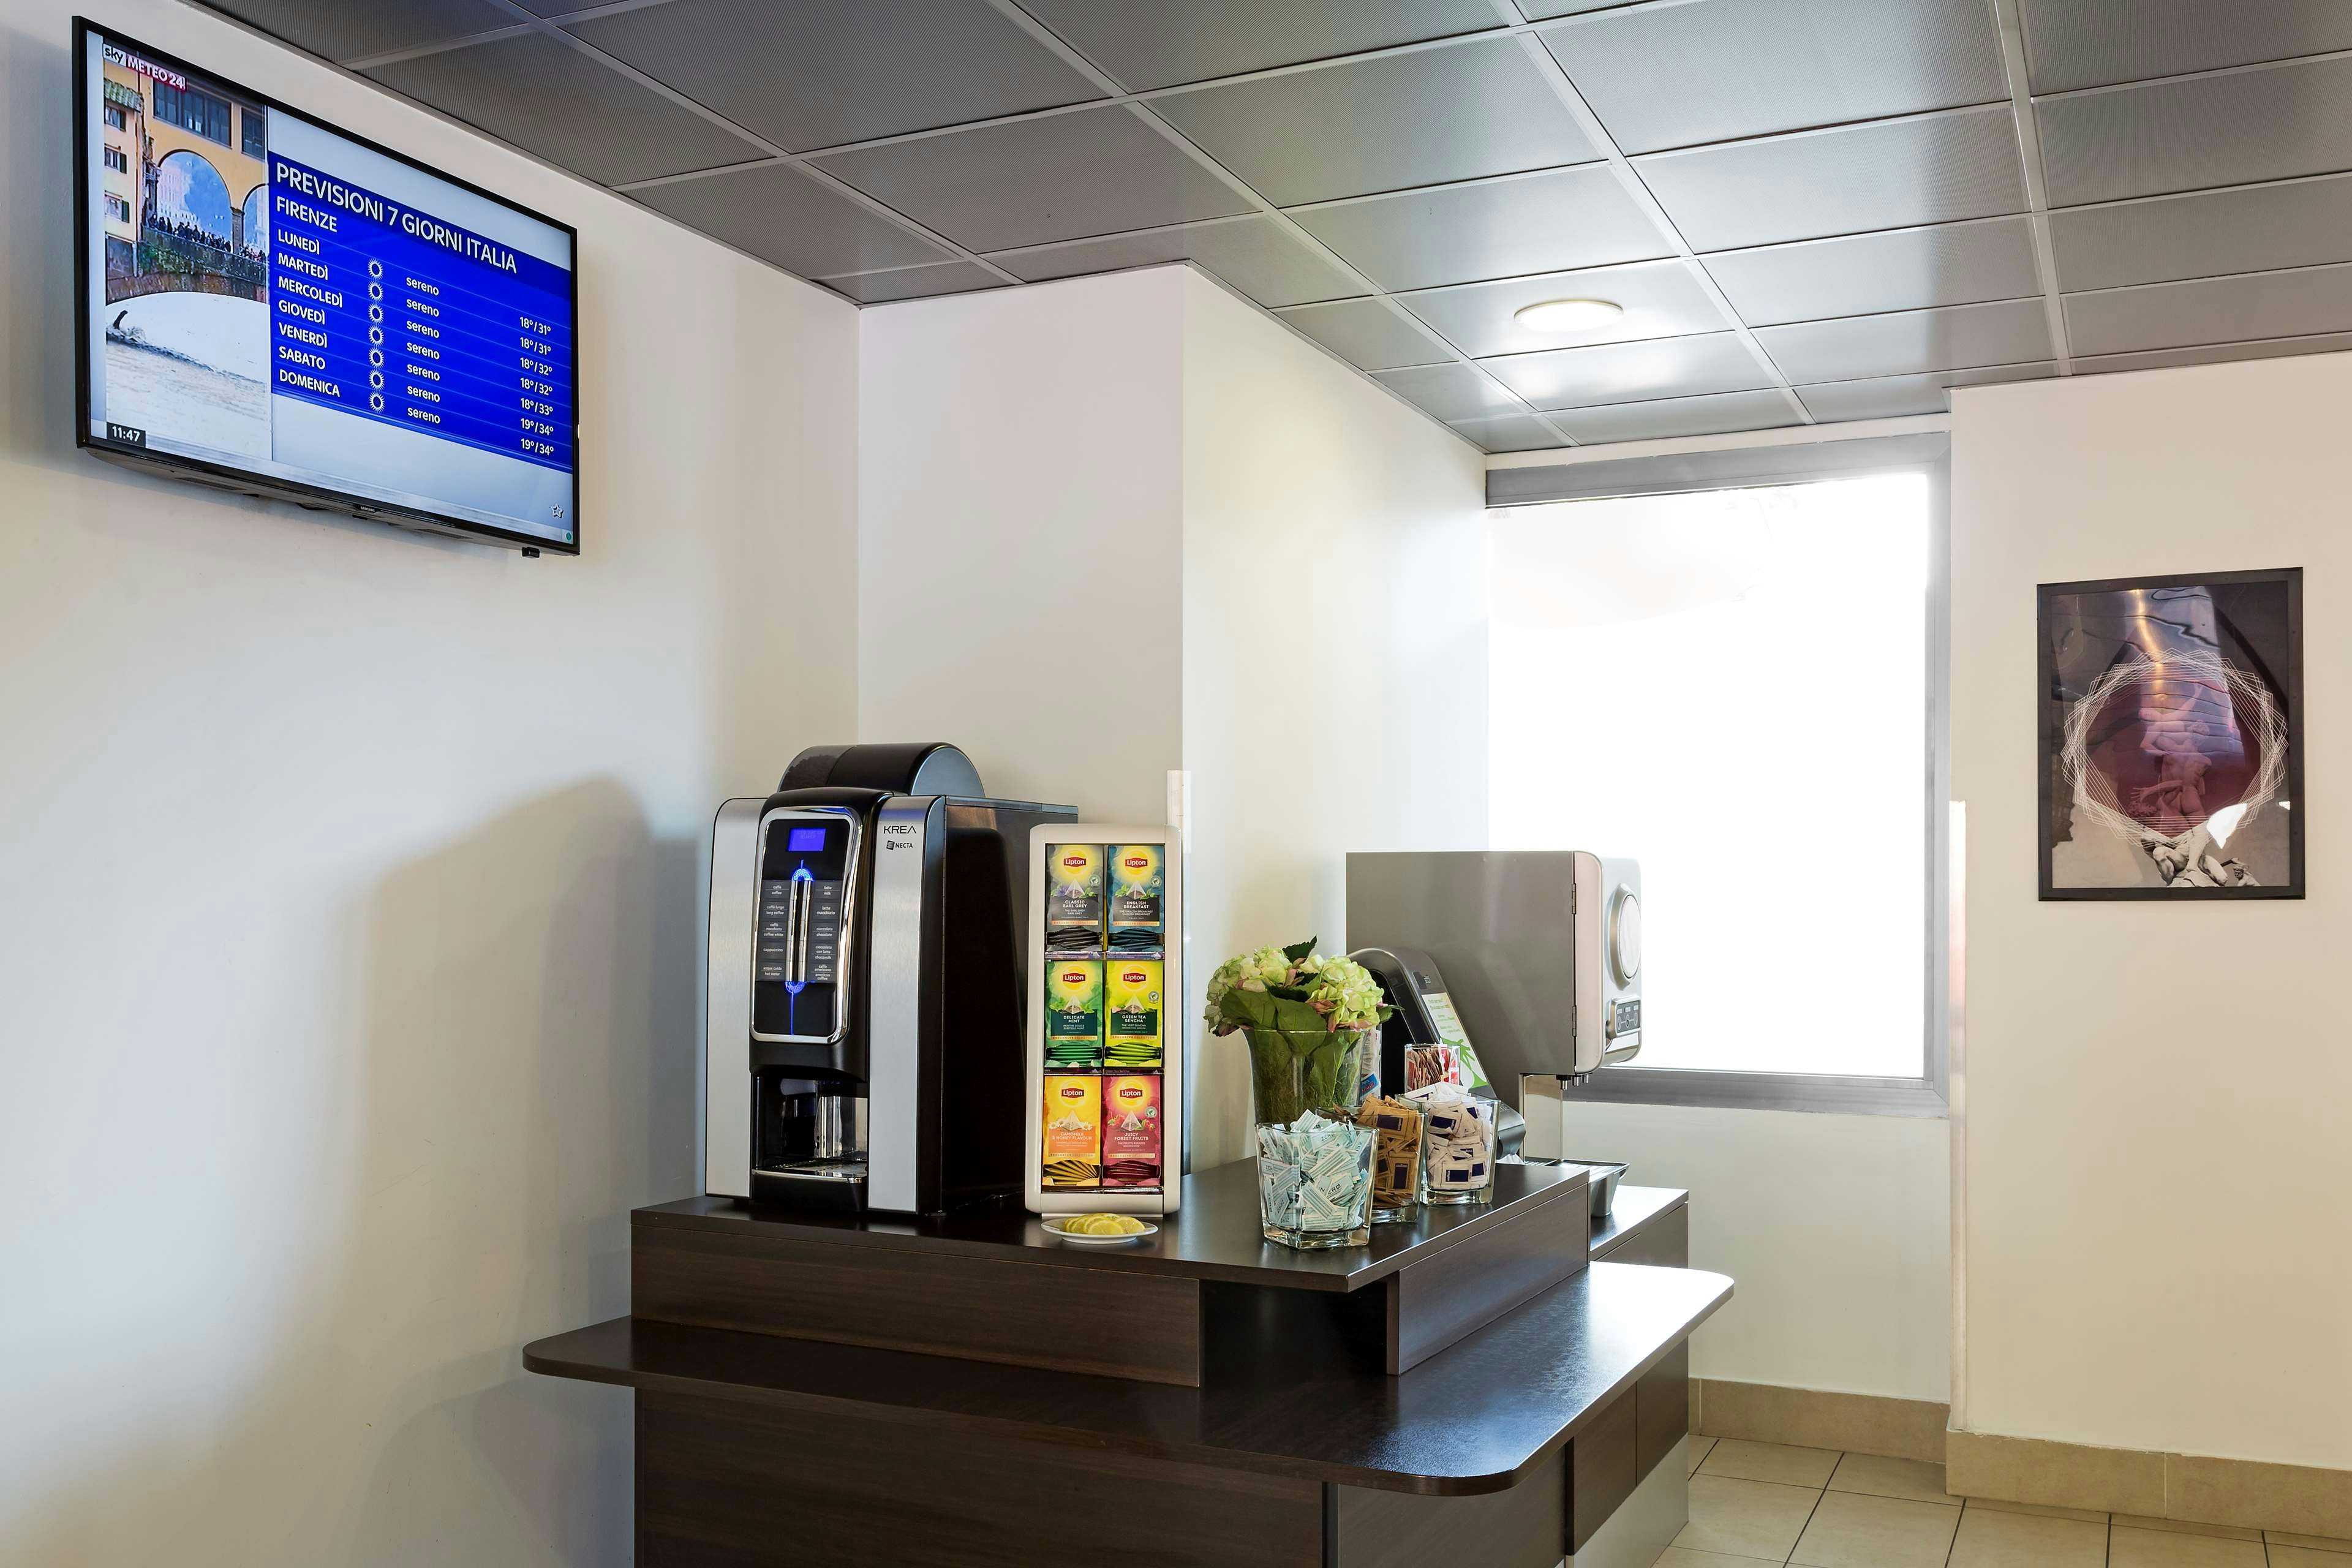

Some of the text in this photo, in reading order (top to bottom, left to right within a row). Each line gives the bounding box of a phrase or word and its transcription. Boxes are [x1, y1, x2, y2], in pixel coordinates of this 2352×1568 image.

[105, 47, 123, 64] sky
[127, 56, 168, 81] METEO
[277, 196, 337, 233] FIRENZE
[277, 162, 516, 274] PREVISIONI 7 GIORNI ITALIA
[278, 229, 320, 255] LUNEDÌ
[405, 276, 440, 296] sereno
[278, 252, 328, 281] MARTEDÌ
[405, 298, 440, 317] sereno
[278, 276, 342, 308] MERCOLEDÌ
[405, 320, 440, 339] sereno
[278, 300, 325, 325] GIOVEDÌ
[405, 342, 440, 360] sereno
[279, 322, 328, 348] VENERDÌ
[405, 364, 440, 382] sereno
[279, 345, 326, 370] SABATO
[405, 385, 440, 402] sereno
[279, 369, 341, 397] DOMENICA
[405, 407, 440, 424] sereno
[113, 426, 140, 442] 11:47
[883, 825, 916, 834] KREA
